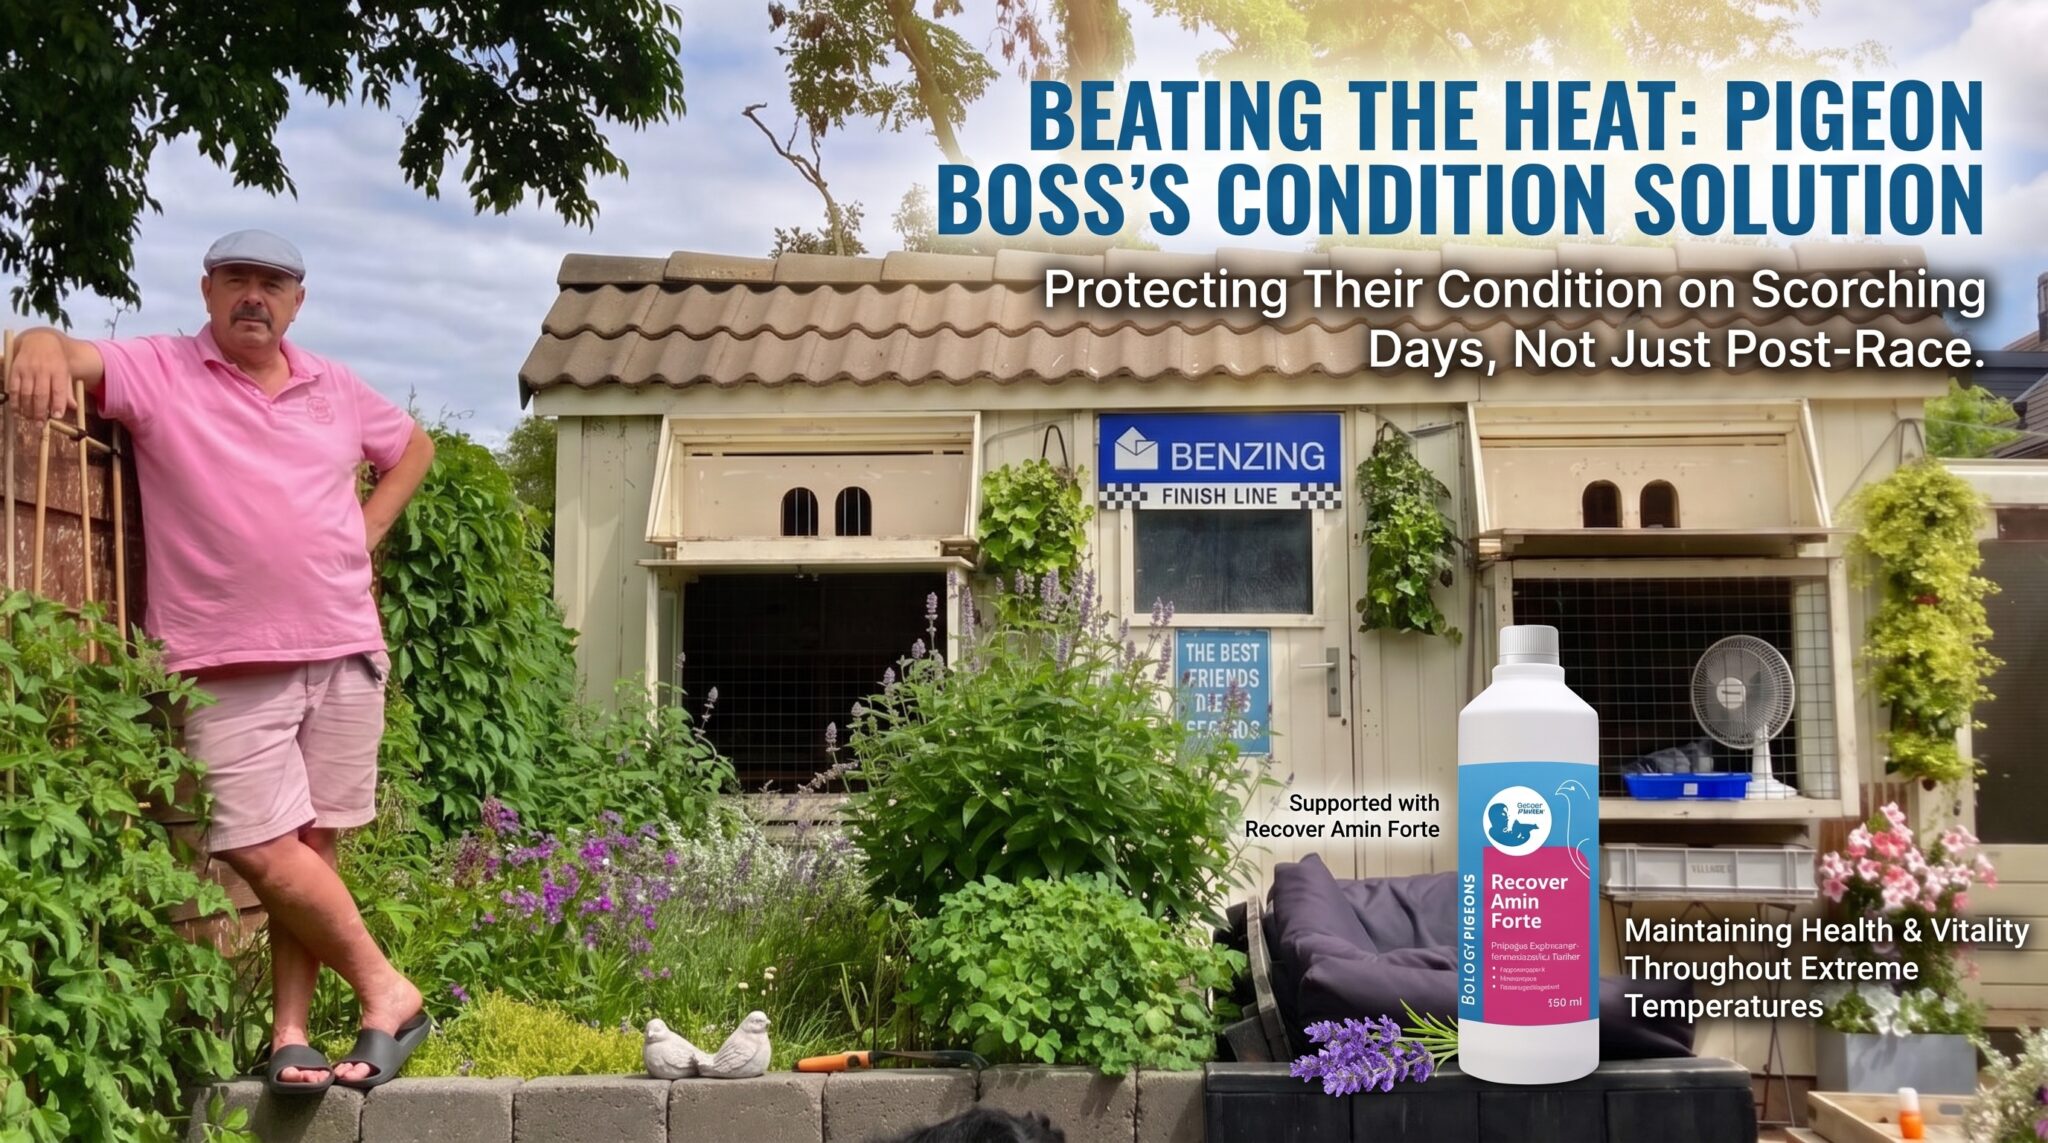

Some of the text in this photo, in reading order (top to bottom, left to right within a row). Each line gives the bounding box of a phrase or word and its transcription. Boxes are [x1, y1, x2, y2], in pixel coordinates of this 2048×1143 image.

[1171, 441, 1326, 471] BENZING
[1162, 487, 1278, 505] FINISH LINE
[1186, 643, 1260, 662] THE BEST
[1188, 668, 1260, 688] FRIENDS
[1491, 873, 1569, 890] Recover
[1463, 874, 1475, 940] PIGEONS
[1490, 893, 1539, 910] Amin
[1491, 913, 1542, 929] Forte
